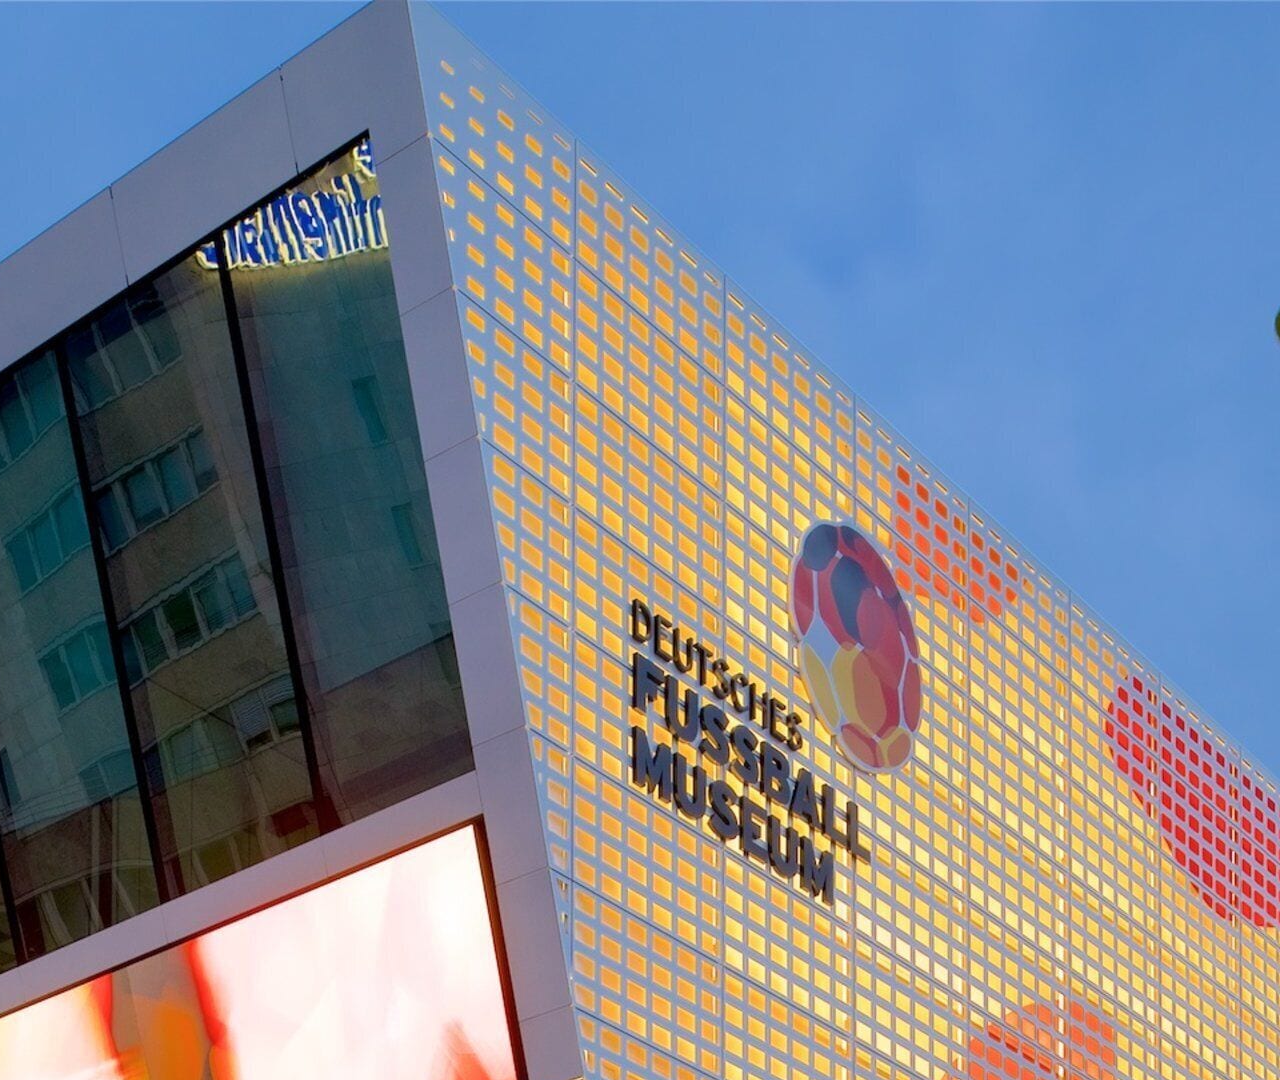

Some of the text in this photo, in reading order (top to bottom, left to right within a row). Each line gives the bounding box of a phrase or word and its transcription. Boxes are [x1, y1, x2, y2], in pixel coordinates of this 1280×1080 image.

[630, 598, 804, 752] DEUTSCHES
[632, 652, 872, 864] FUSSBALL
[631, 726, 836, 906] MUSEUM
